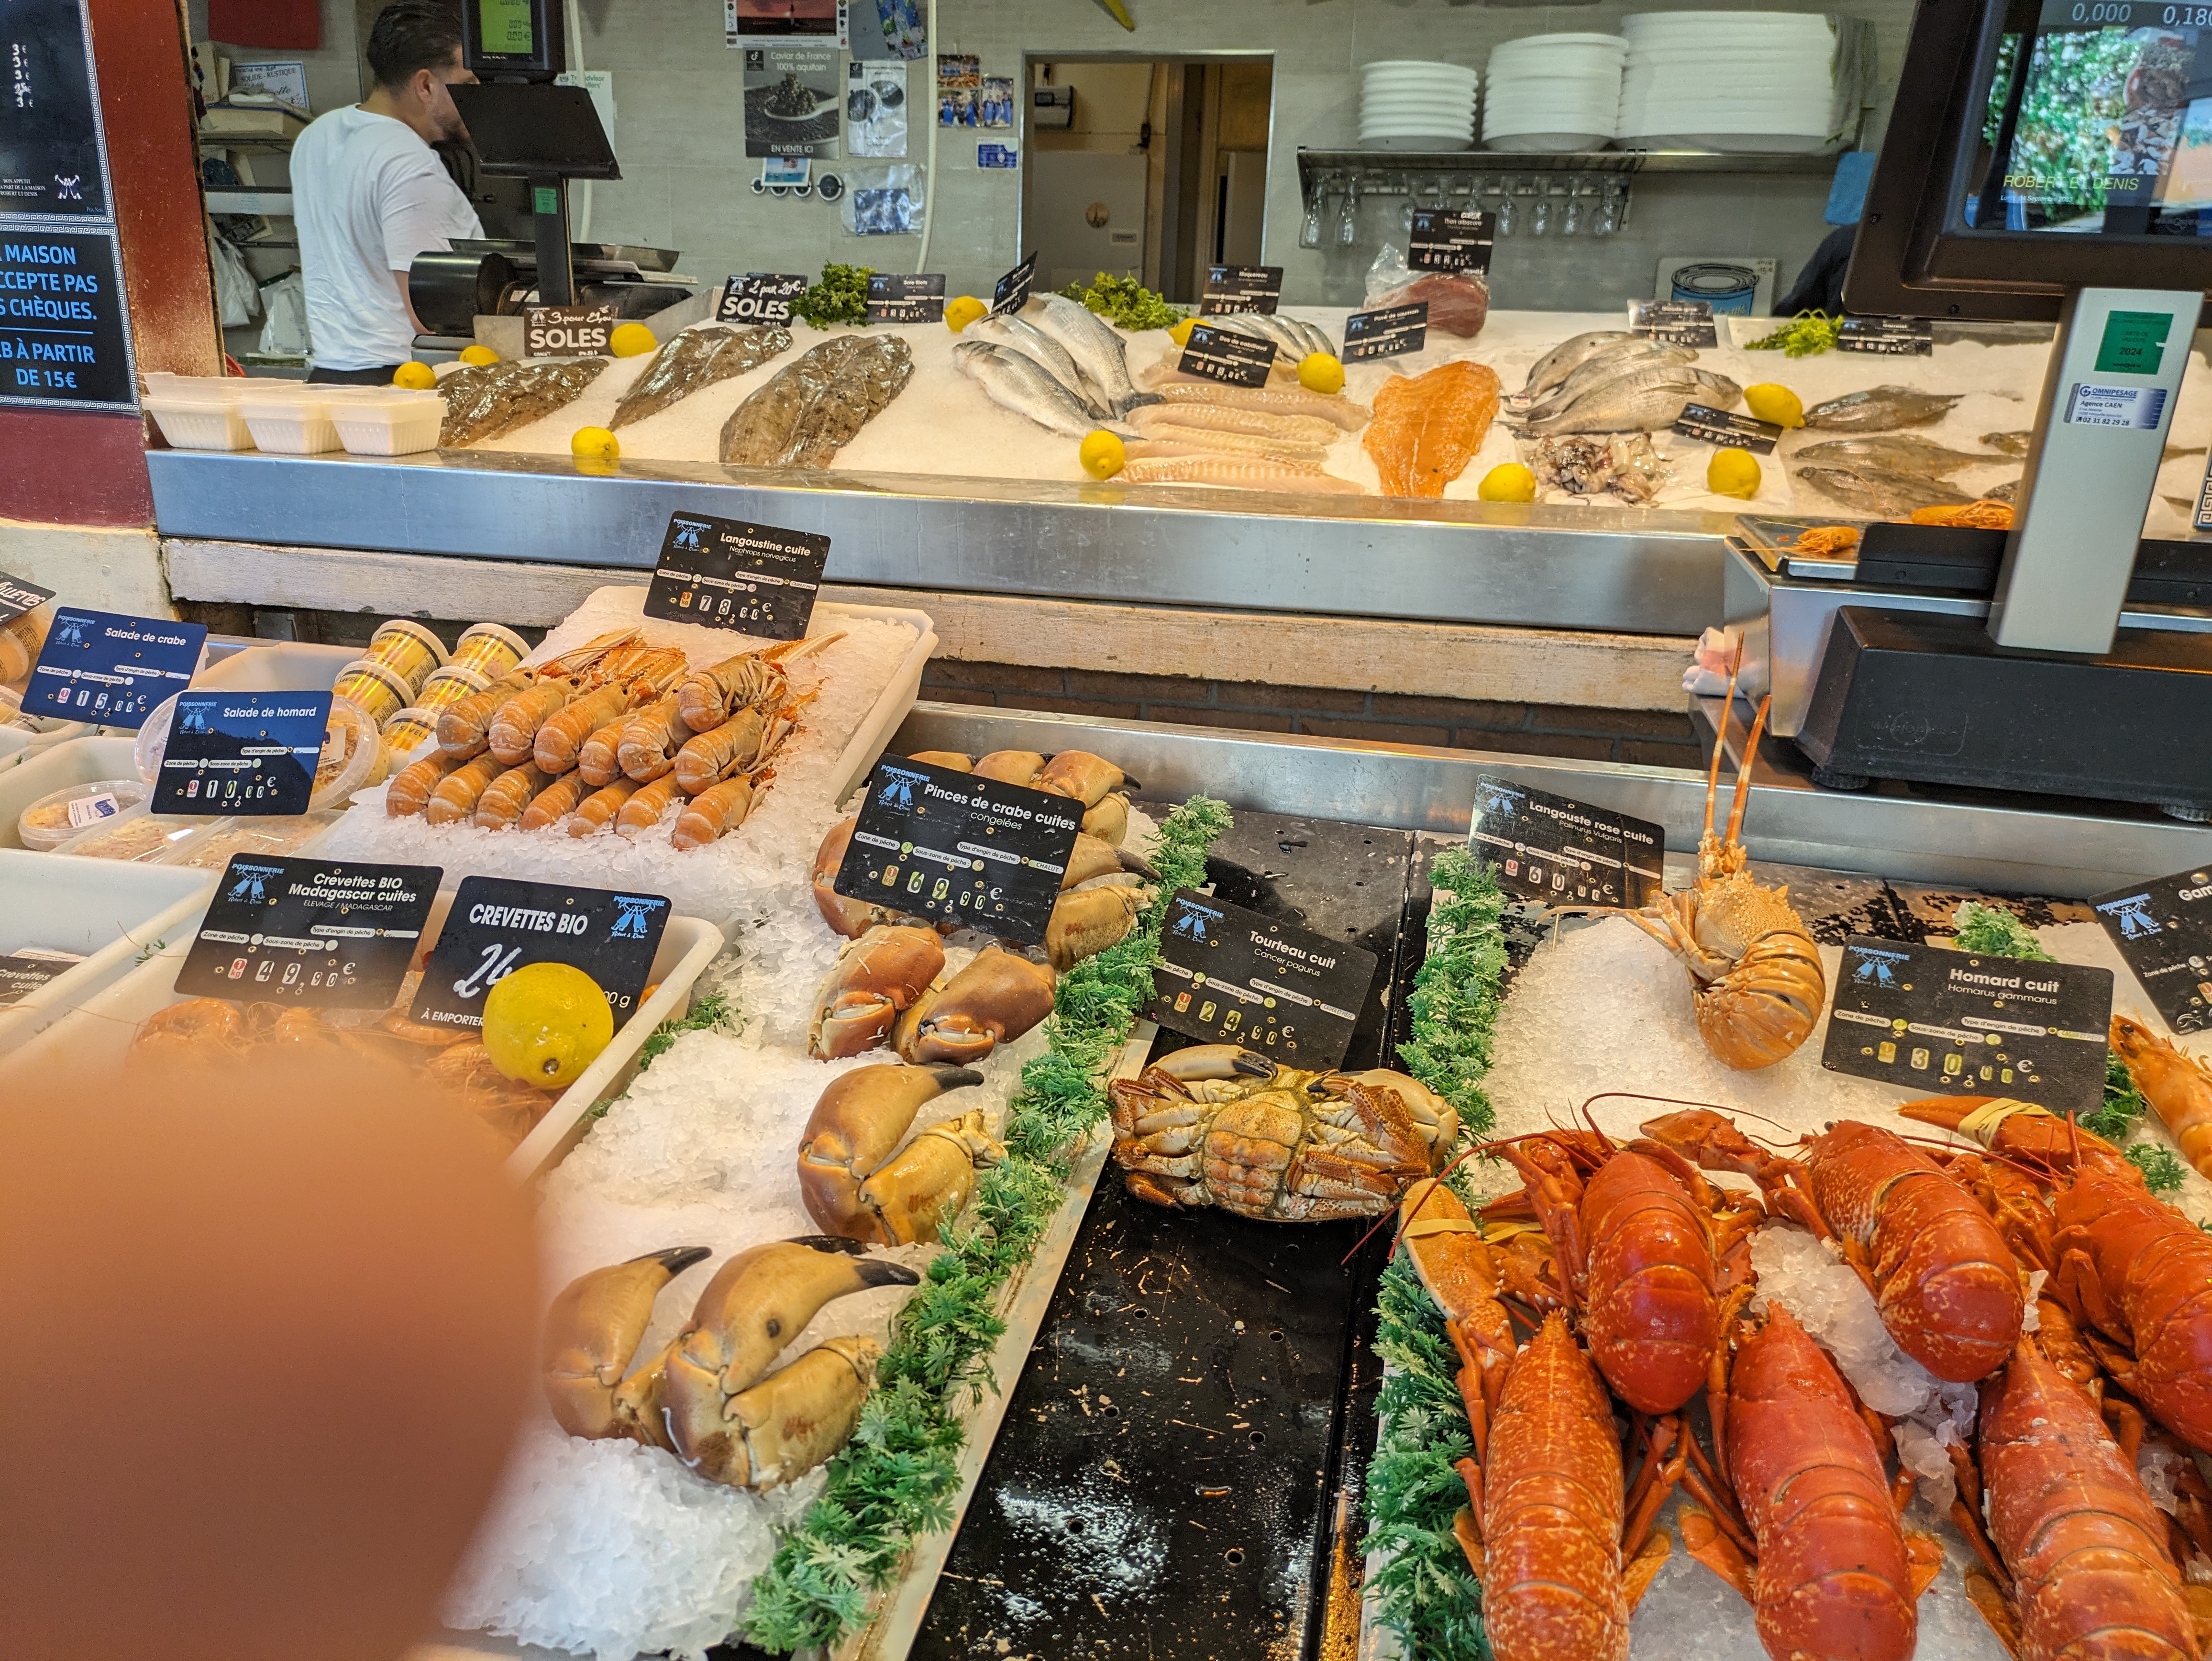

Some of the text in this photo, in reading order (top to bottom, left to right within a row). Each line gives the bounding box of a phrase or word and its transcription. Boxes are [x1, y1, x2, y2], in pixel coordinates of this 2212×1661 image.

[2072, 3, 2132, 23] 0,000
[12, 44, 20, 55] 3
[771, 51, 831, 61] Caviar de France
[12, 56, 21, 67] 3
[15, 70, 22, 80] 3
[16, 97, 23, 107] 3
[783, 144, 804, 153] VENTE
[2092, 177, 2139, 190] DENIS
[5, 244, 76, 265] MAISON
[64, 274, 98, 293] PAS
[748, 279, 761, 294] 2
[10, 295, 97, 321] CHÈQUES.
[722, 296, 789, 320] SOLES
[1397, 309, 1419, 318] saumon
[548, 312, 562, 324] 3
[530, 328, 607, 349] SOLES
[1219, 335, 1230, 343] Dos
[1239, 341, 1268, 352] cabillaud
[16, 337, 96, 364] À PARTIR
[2119, 347, 2143, 356] 2024
[16, 368, 77, 388] DE 15€
[2092, 388, 2138, 397] OMNIPESAGE
[673, 518, 712, 530] POISSONNERIE
[720, 532, 811, 556] Langoustine cuite
[730, 546, 796, 563] Nephrops norvegicus
[700, 596, 772, 620] 78,90 €
[57, 615, 96, 625] POISSONNERIE
[105, 627, 186, 646] Salade de crabe
[77, 691, 146, 712] 15,00 €
[223, 707, 317, 717] Salade de homard
[881, 764, 931, 782] POISSONNERIE
[207, 776, 276, 802] 10,00 €
[1480, 782, 1526, 798] POISSONNERIE
[924, 785, 1076, 831] Pinces de crabe cuites
[970, 811, 1023, 830] congelées
[1529, 801, 1654, 845] Langouste rose cuite
[1559, 820, 1622, 843] Palinurus Vulgaris
[903, 842, 912, 851] 27
[232, 863, 285, 875] POISSONNERIE
[1036, 862, 1060, 872] CHALUT
[313, 873, 402, 889] Crevettes BIO
[884, 877, 893, 885] kg
[288, 883, 417, 902] Madagascar cuites
[907, 872, 1002, 909] 69,90 €
[1603, 884, 1614, 895] €
[303, 900, 393, 911] ELEVAGE MADAGASCAR
[613, 896, 665, 907] POISSONNERIE
[1175, 897, 1225, 919] POISSONNERIE
[2096, 893, 2151, 912] POISSONNERIE
[469, 904, 588, 935] CREVETTES BIO
[1250, 930, 1337, 969] Tourteau cuit
[1848, 945, 1910, 961] POISSONNERIE
[1254, 948, 1321, 977] Cancer pagurus
[231, 969, 241, 978] kg
[256, 961, 356, 989] 49,90 €
[1950, 968, 2060, 994] Homard cuit
[2144, 969, 2159, 978] Zone
[619, 995, 631, 1008] g
[1948, 984, 2057, 1005] Homarus gammarus
[420, 1008, 430, 1019] À
[1177, 1001, 1186, 1011] kg
[1200, 1002, 1294, 1044] 24,90 €
[2017, 1060, 2032, 1073] €
